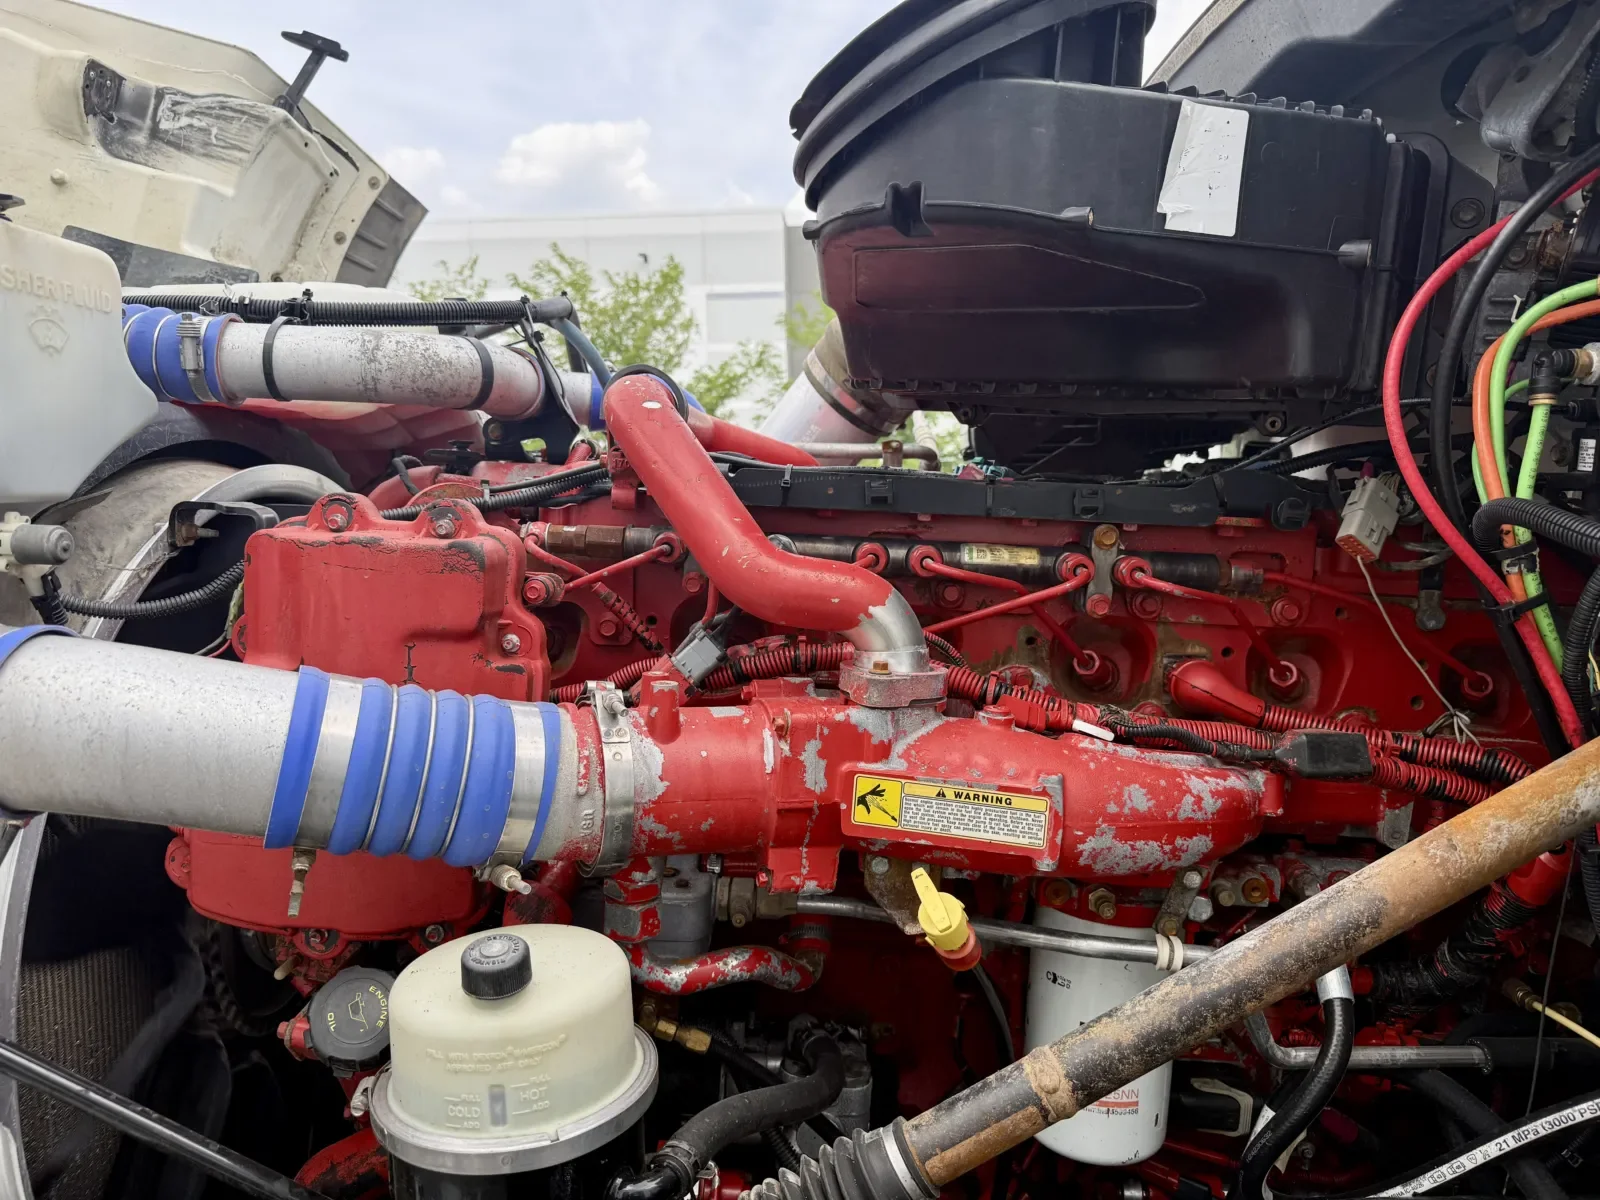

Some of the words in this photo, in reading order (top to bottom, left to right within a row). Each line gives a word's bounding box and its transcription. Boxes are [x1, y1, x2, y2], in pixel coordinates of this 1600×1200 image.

[60, 280, 112, 313] FLUID
[954, 790, 1012, 806] WARNING
[368, 986, 388, 1028] ENGINE
[328, 1012, 336, 1032] OIL
[520, 1086, 548, 1102] HOT
[448, 1104, 480, 1118] COLD
[532, 1100, 550, 1110] ADD
[463, 1121, 480, 1129] ADD
[1495, 1140, 1510, 1152] 21
[1512, 1128, 1540, 1146] MPa
[1541, 1111, 1577, 1134] (3000
